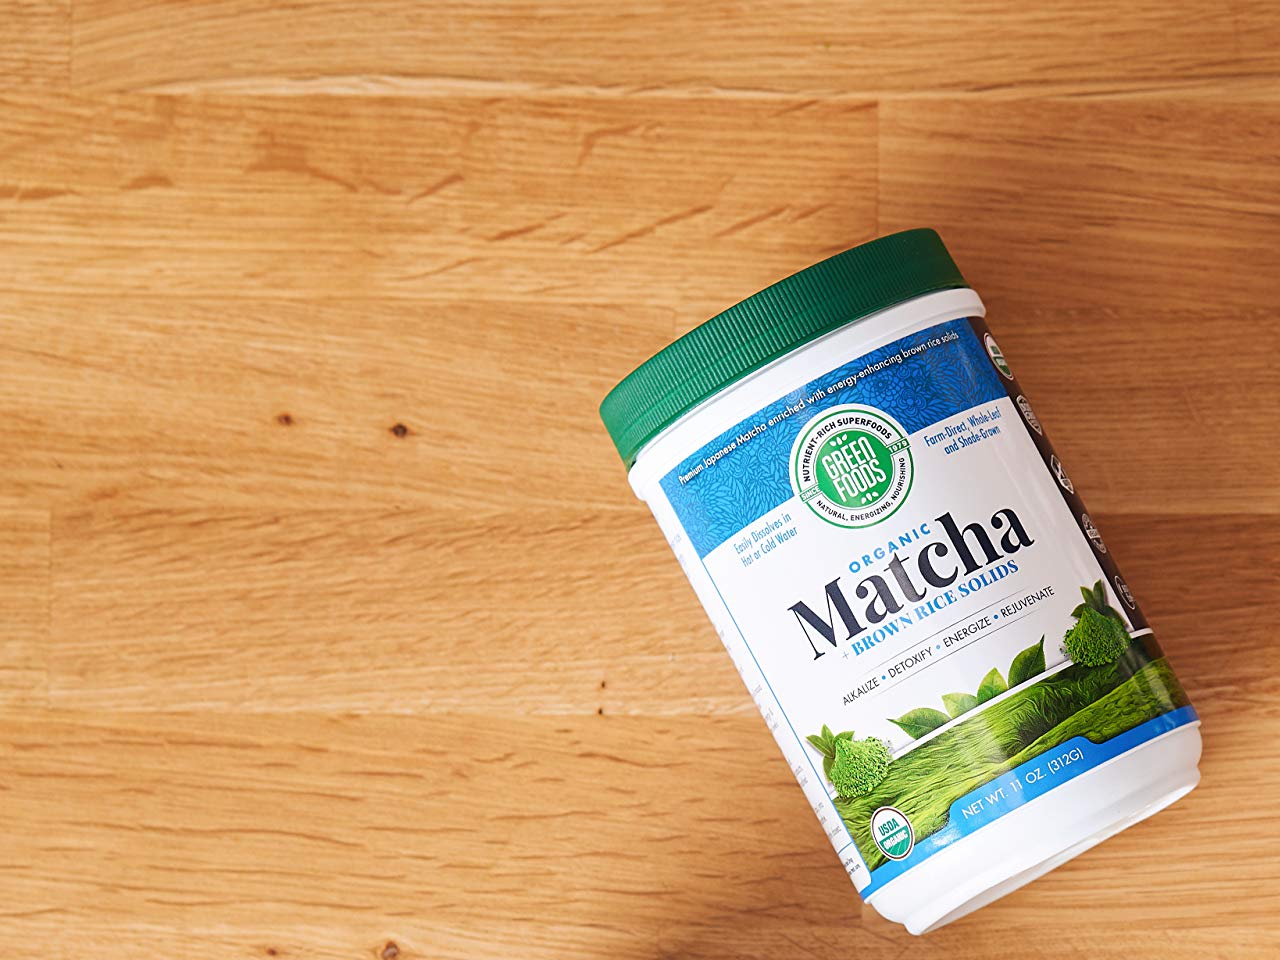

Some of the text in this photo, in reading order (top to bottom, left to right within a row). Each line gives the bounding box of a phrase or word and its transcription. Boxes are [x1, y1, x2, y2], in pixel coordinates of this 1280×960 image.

[679, 330, 959, 485] Premium Japanese Matcha enriched with energy-enhancing brown rice solids
[923, 421, 970, 447] Farm-Direct,
[967, 406, 1002, 427] Whole-Leaf
[802, 417, 893, 483] NUTRIENT-RICH SUPERFOODS
[821, 436, 877, 480] GREEN
[944, 425, 1001, 455] and Shade-Grown
[801, 441, 908, 500] SINCE 1979
[816, 457, 906, 522] NATURAL, ENERGIZING, NOURISHING
[832, 458, 887, 503] FOODS
[733, 513, 792, 555] Easily Dissolves in
[740, 527, 798, 567] Hot or Cold Water
[848, 523, 931, 573] ORGANIC
[787, 508, 1035, 660] Matcha
[851, 612, 914, 656] BROWN
[913, 589, 958, 620] RICE
[959, 559, 1019, 598] SOLIDS
[842, 585, 1055, 706] ALKALIZE DETOXIFY ENERGIZE REJUVENATE
[961, 747, 1085, 819] NET WT. 11 OZ. (312G)
[878, 818, 900, 836] USDA
[883, 829, 909, 850] ORGANIC
